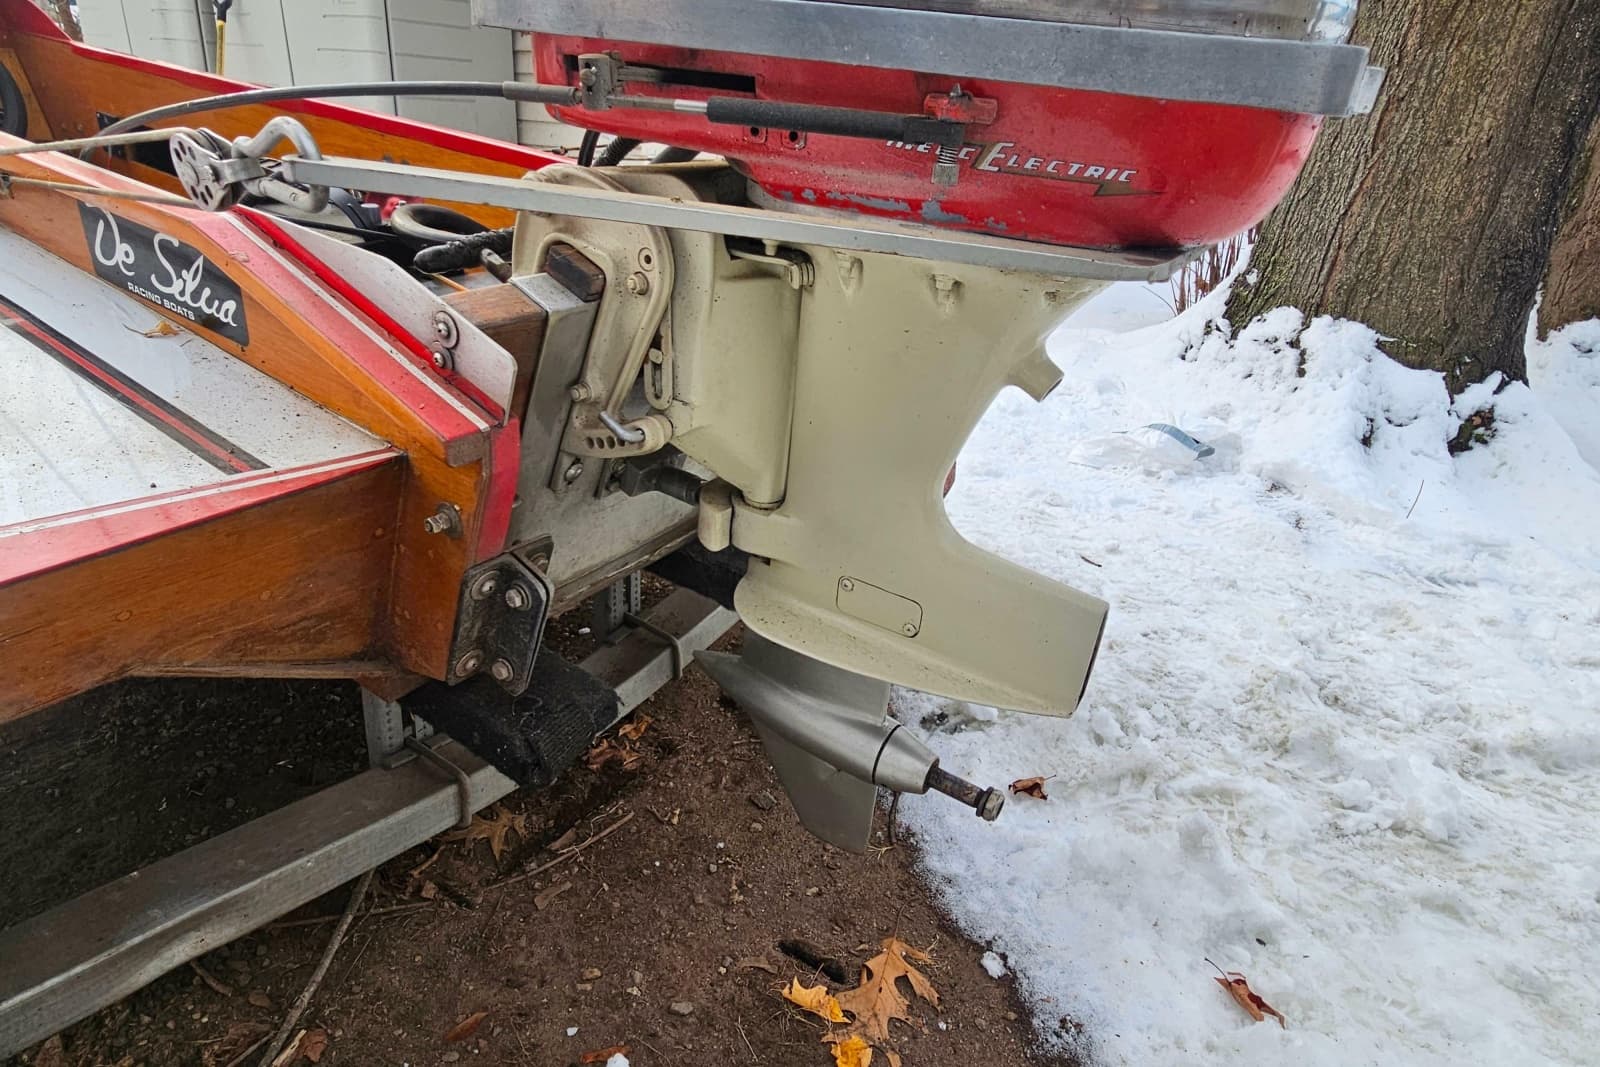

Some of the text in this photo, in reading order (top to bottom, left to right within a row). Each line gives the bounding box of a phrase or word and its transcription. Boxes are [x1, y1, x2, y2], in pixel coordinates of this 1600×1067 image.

[88, 204, 238, 326] De Silva
[127, 282, 195, 320] RACING BOATS
